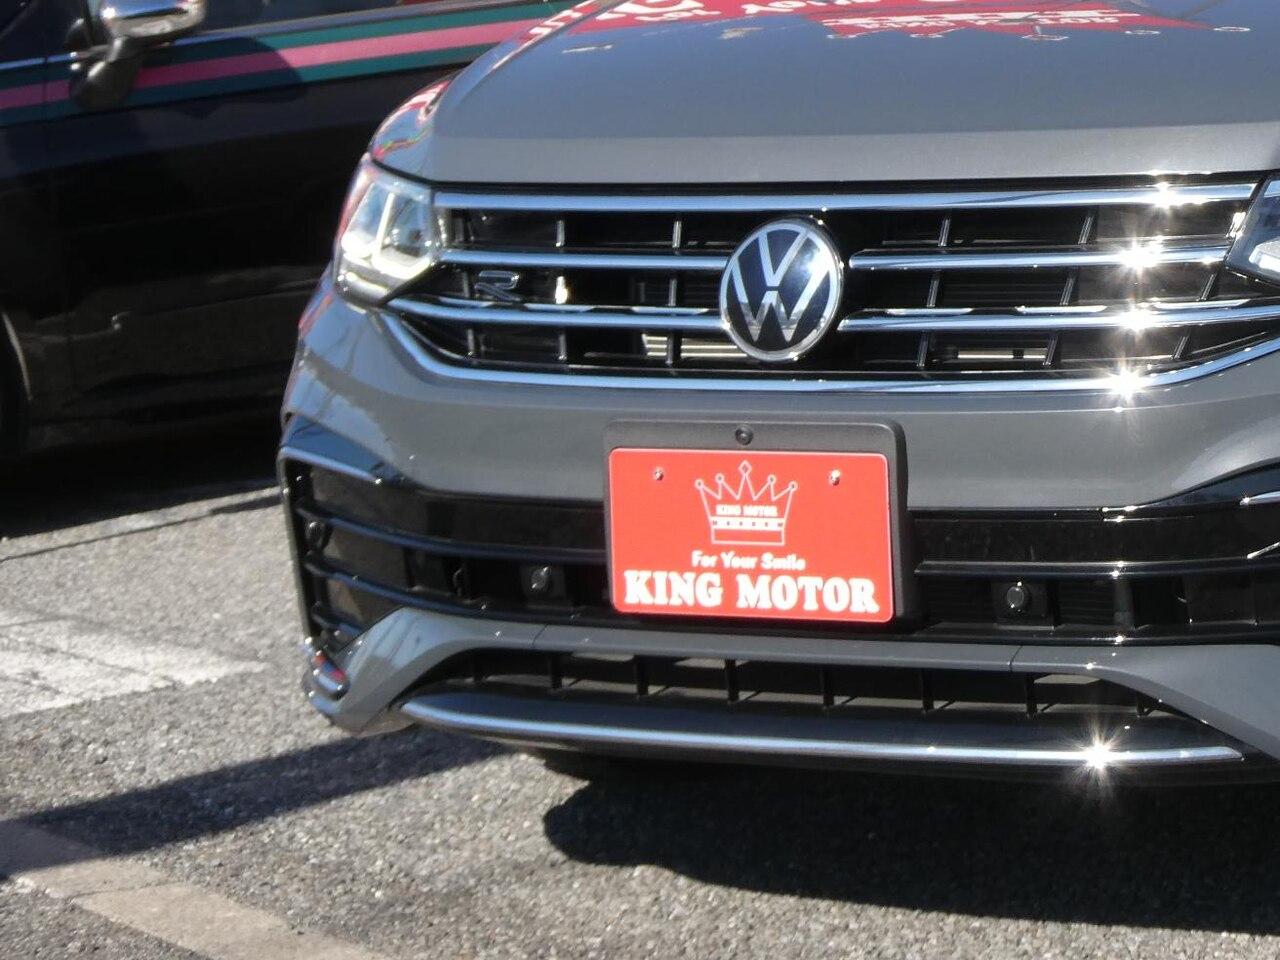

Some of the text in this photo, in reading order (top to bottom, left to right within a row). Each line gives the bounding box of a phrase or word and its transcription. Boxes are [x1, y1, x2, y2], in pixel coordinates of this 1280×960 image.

[692, 550, 806, 571] For Your Smile
[624, 570, 880, 614] KING MOTOR
